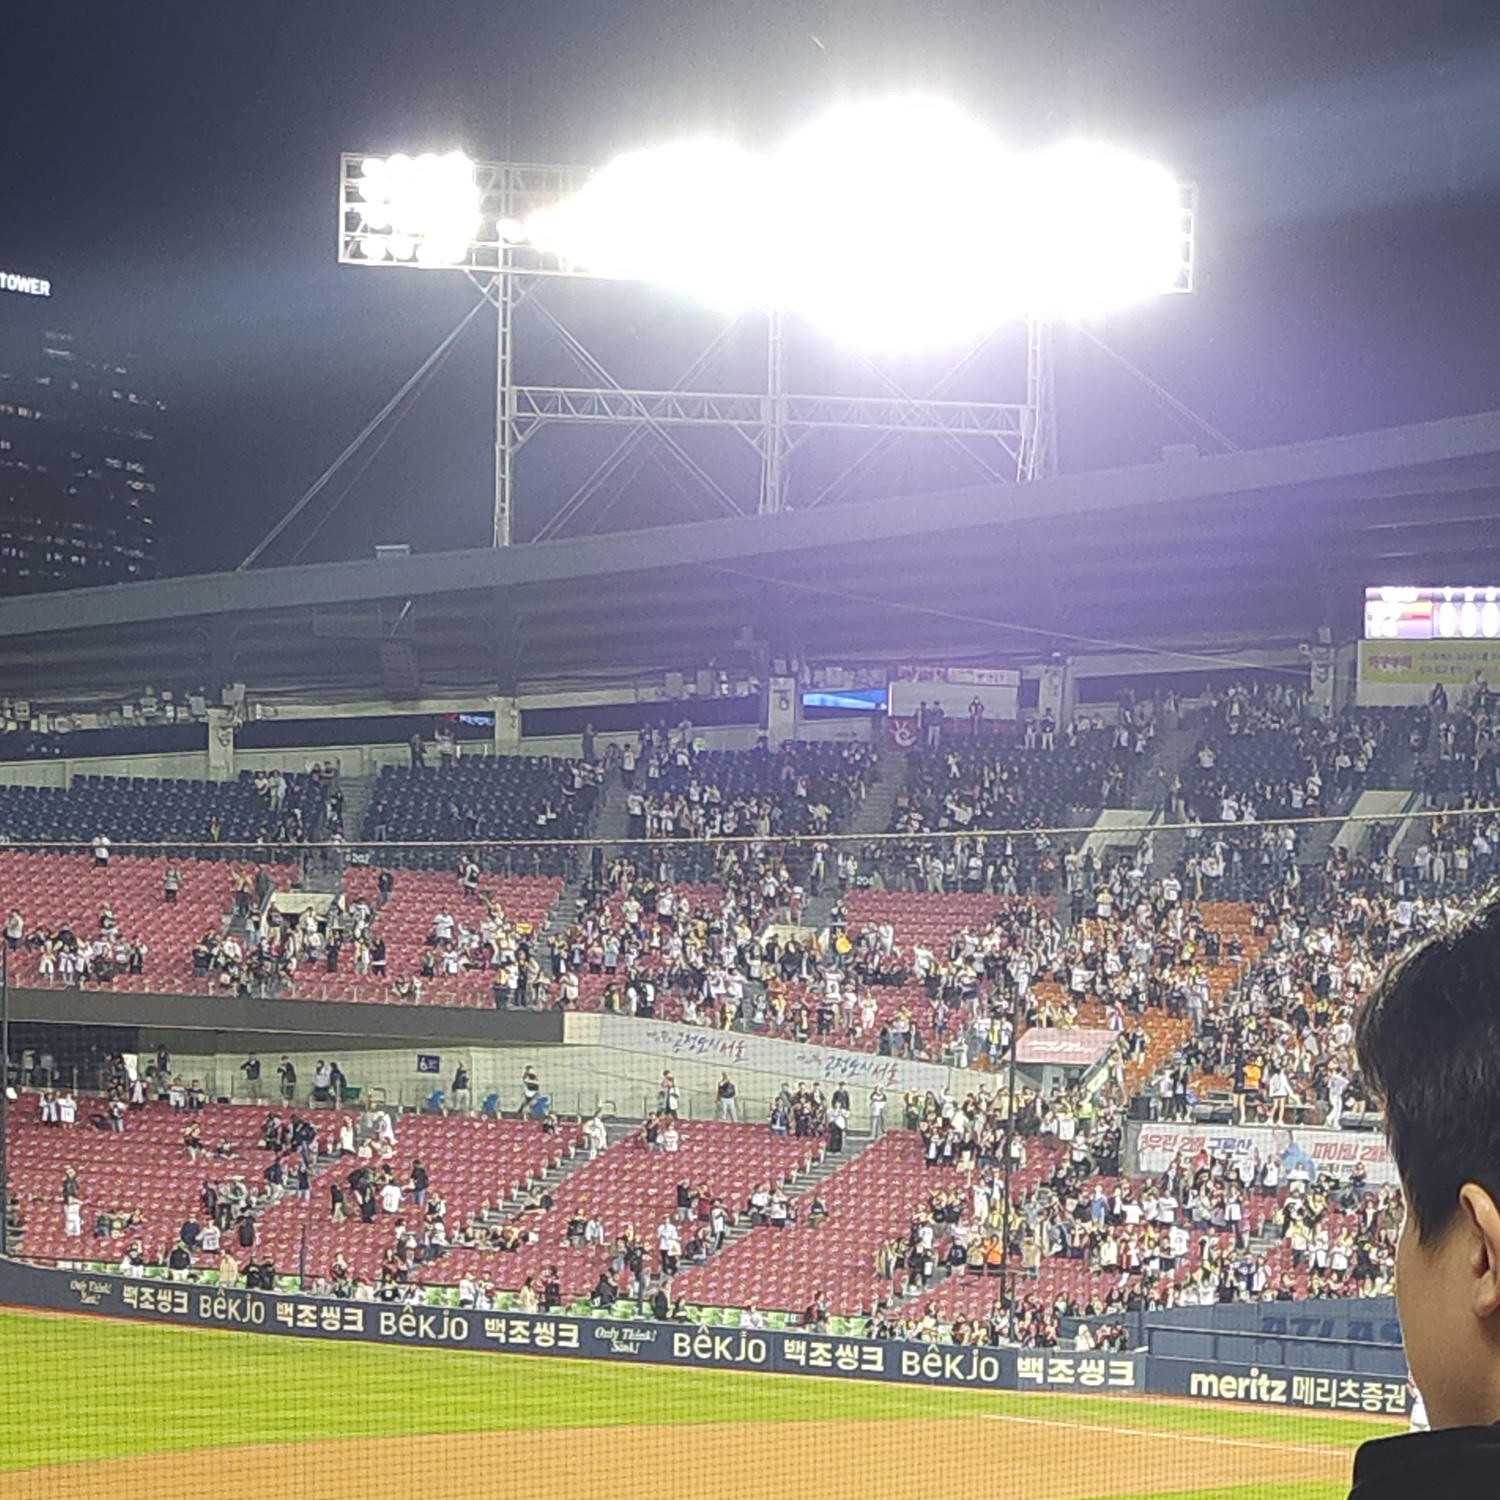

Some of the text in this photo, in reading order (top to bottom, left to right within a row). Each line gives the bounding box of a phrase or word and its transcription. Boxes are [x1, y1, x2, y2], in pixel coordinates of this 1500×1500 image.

[0, 271, 51, 297] TOWER
[122, 1284, 188, 1314] 백조씽크
[276, 1301, 364, 1332] 백조씽크
[484, 1317, 580, 1348] 백조씽크
[784, 1339, 884, 1372] 백조씽크
[1017, 1357, 1135, 1387] 백조씽크
[1190, 1368, 1406, 1413] meritz 메리츠증권
